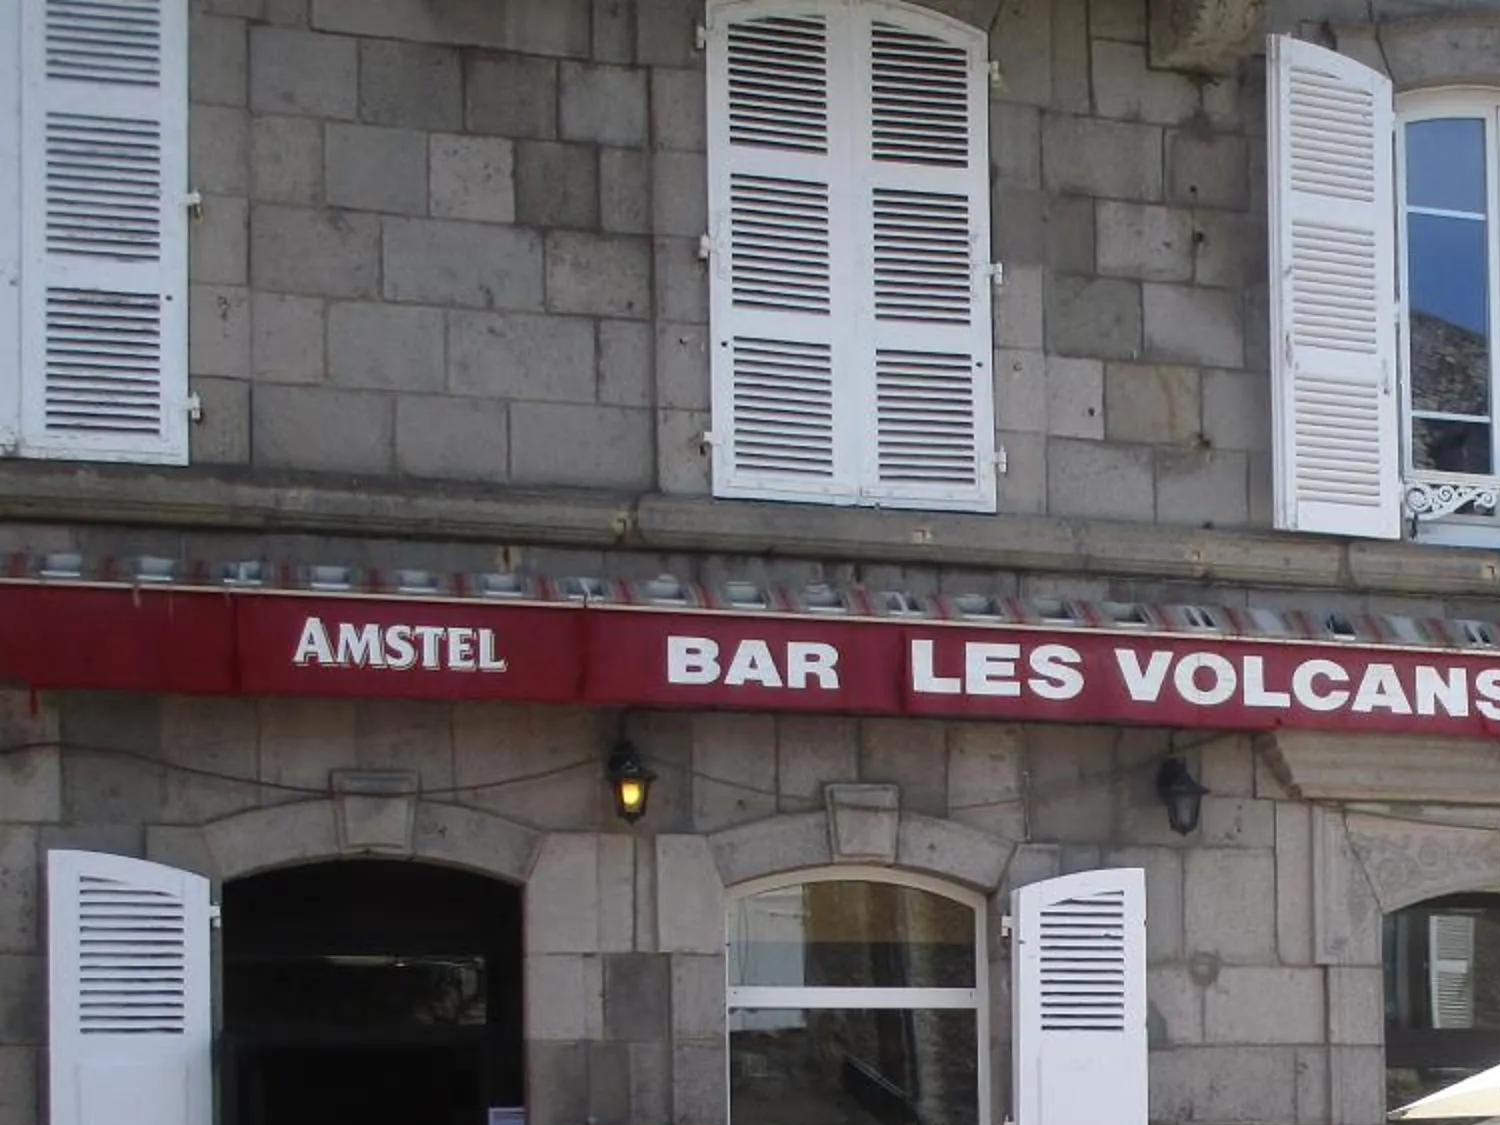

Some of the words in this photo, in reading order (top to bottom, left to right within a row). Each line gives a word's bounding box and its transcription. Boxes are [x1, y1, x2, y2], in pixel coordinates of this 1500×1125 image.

[292, 615, 508, 673] AMSTEL
[667, 635, 841, 690] BAR
[910, 639, 1086, 700] LES
